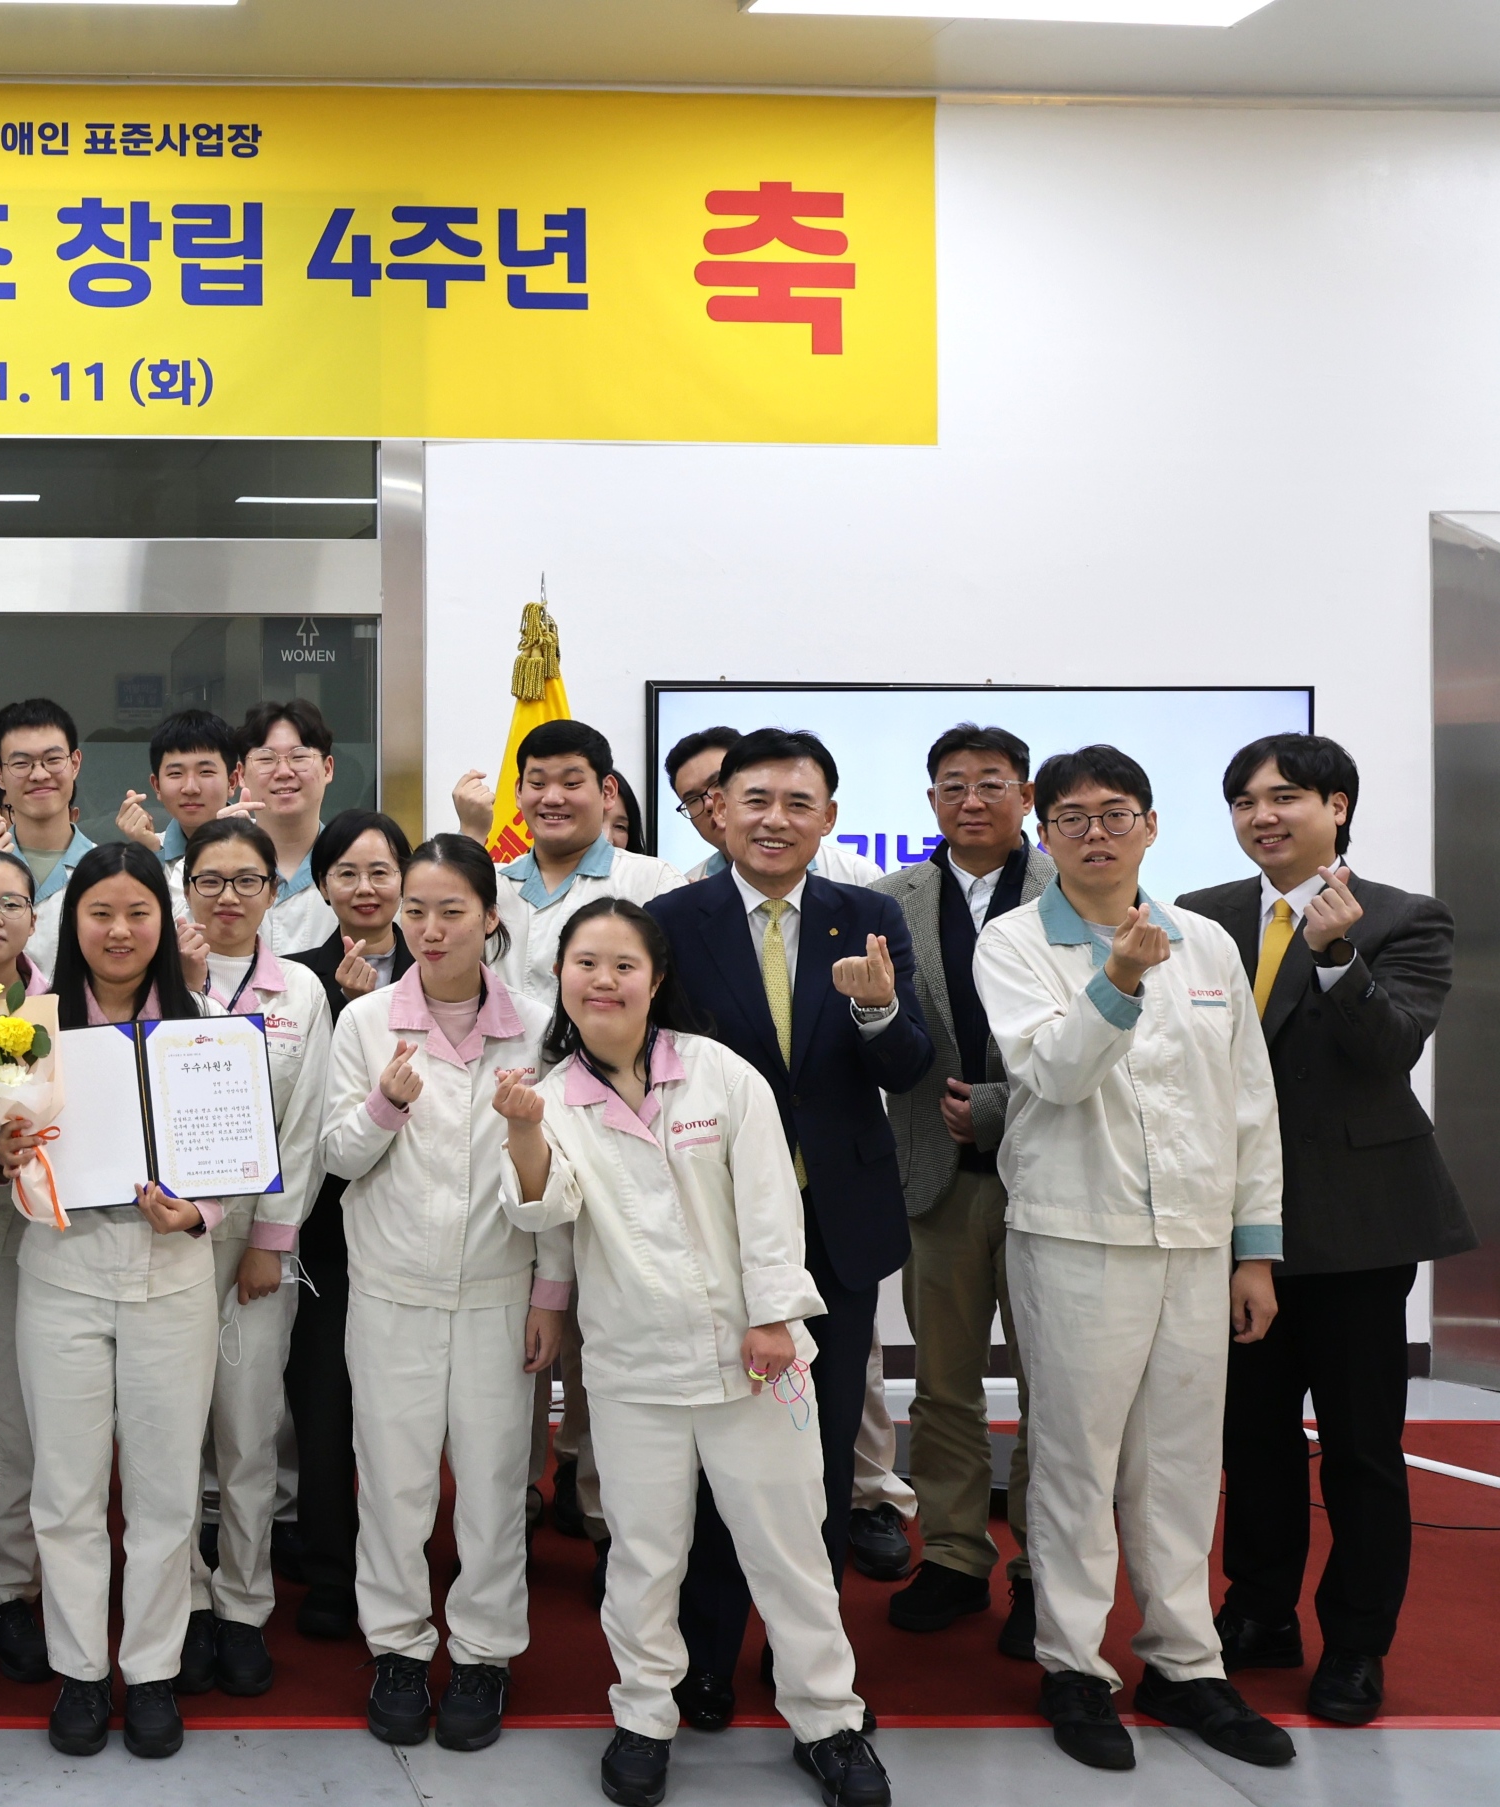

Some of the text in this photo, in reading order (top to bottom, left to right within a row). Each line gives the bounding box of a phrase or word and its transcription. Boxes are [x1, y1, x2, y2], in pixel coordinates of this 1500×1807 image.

[85, 123, 261, 158] 표준사업장
[56, 198, 263, 309] 창립
[307, 205, 589, 310] 4주년
[694, 182, 856, 355] 축
[52, 362, 103, 401] 11
[130, 359, 214, 408] (화)
[280, 650, 336, 662] WOMEN
[684, 1117, 718, 1130] OTTOGI
